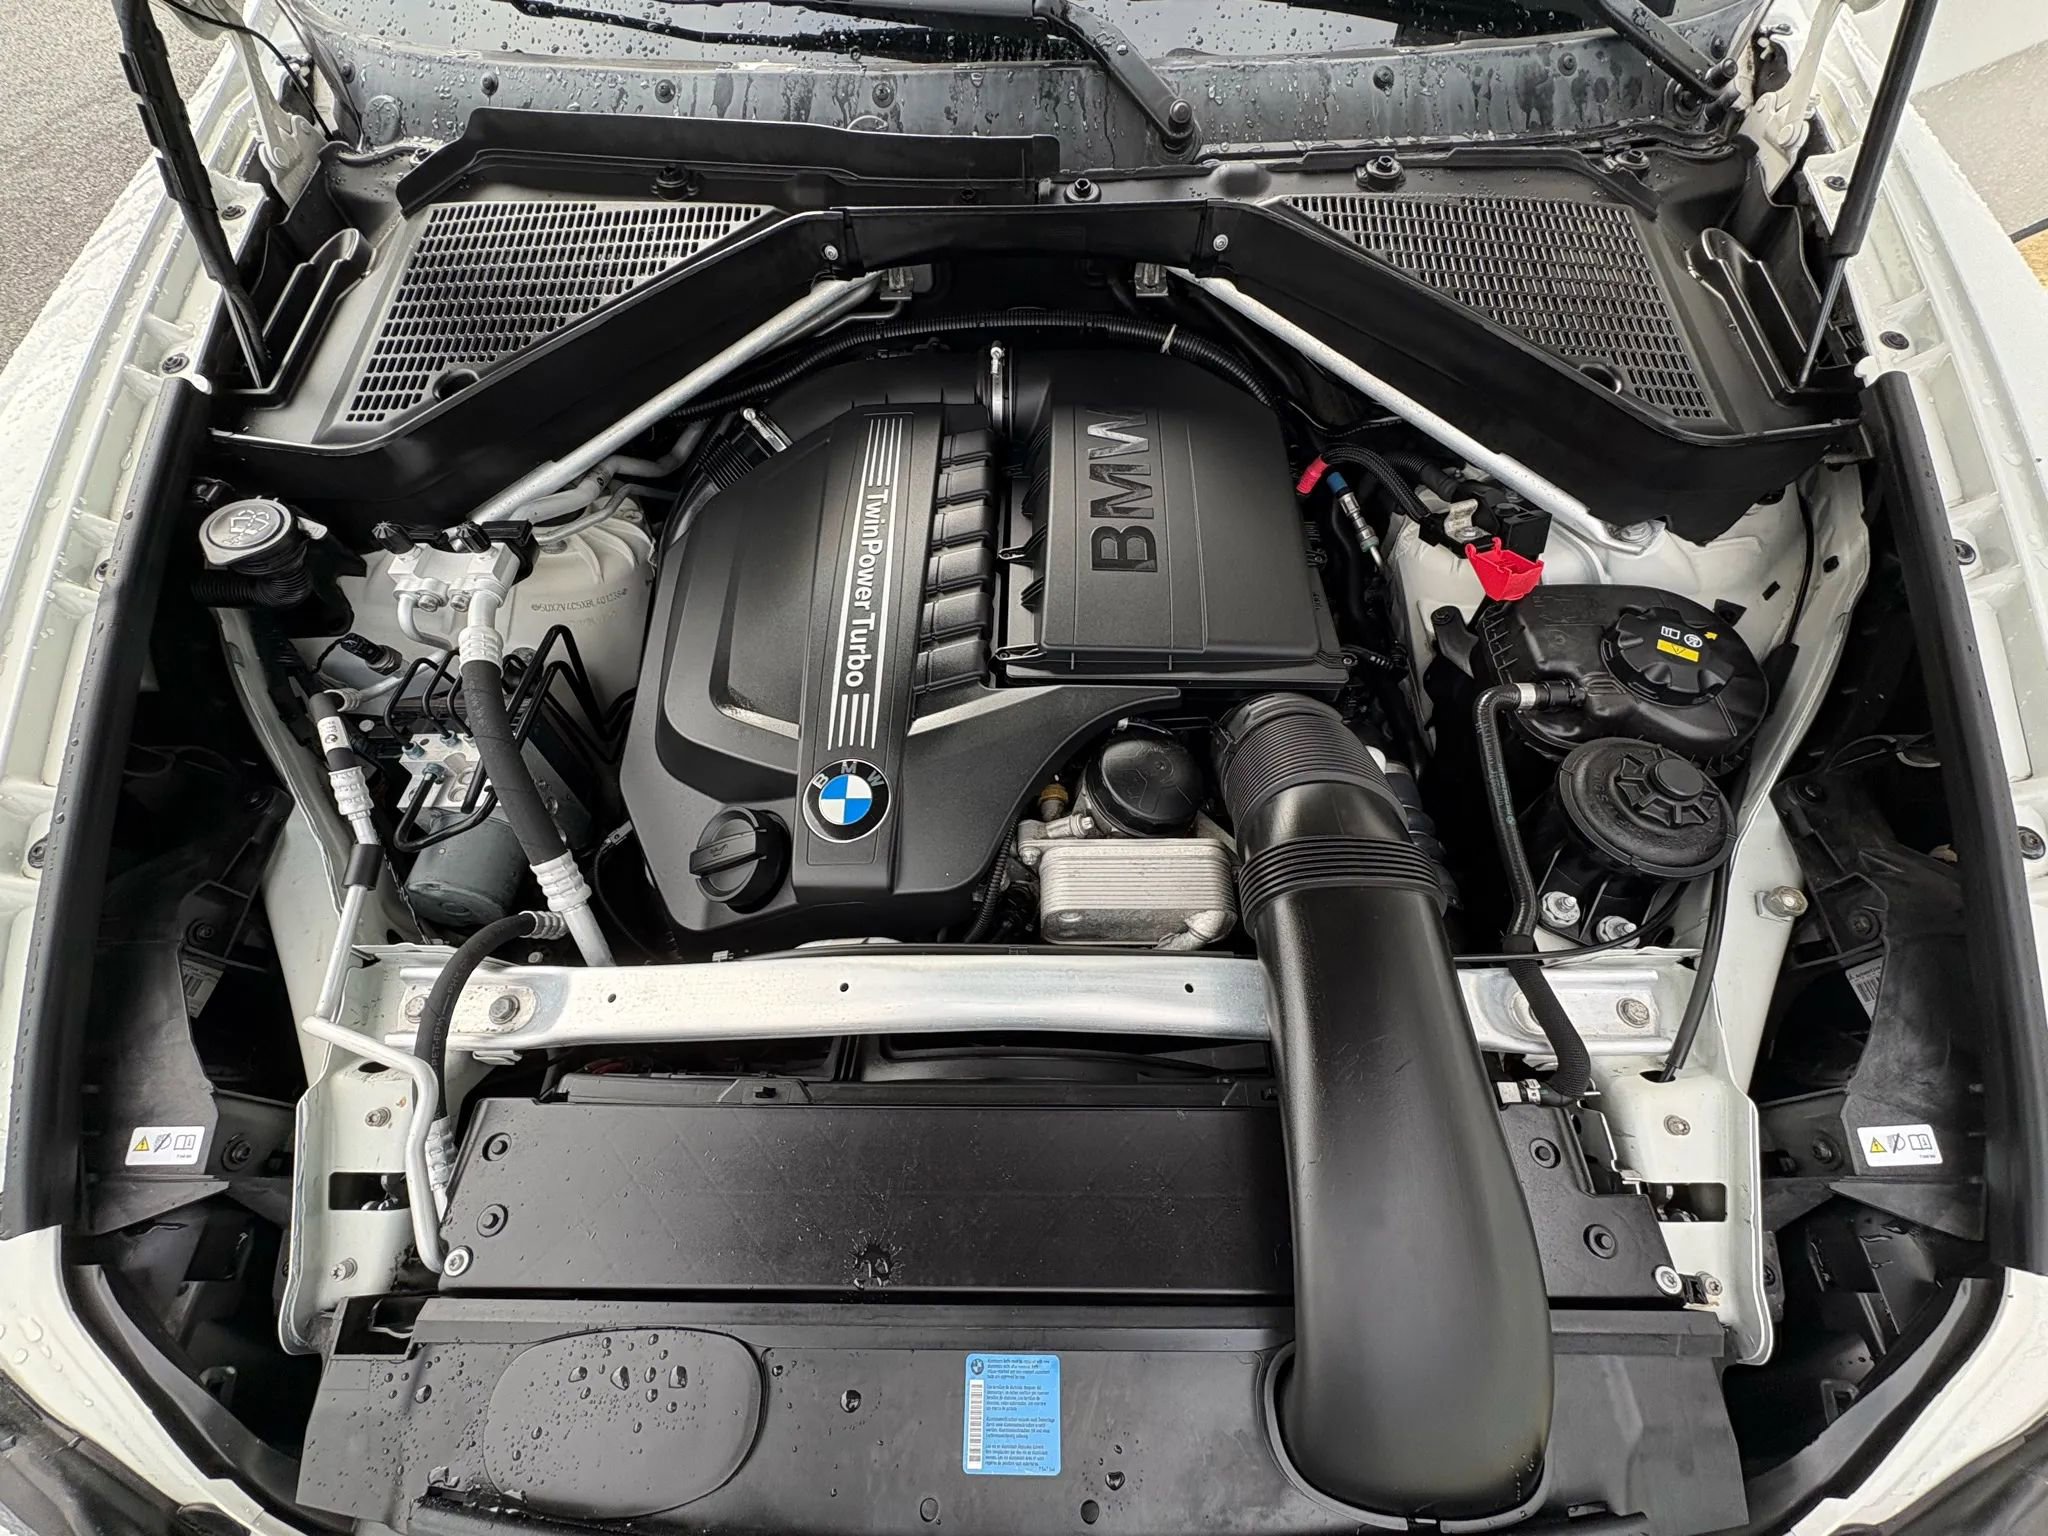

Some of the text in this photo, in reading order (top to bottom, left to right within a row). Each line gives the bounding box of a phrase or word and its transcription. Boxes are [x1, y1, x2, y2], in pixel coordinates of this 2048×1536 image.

[1087, 409, 1158, 573] BMW
[845, 612, 876, 688] Turbo
[812, 760, 885, 790] BMW
